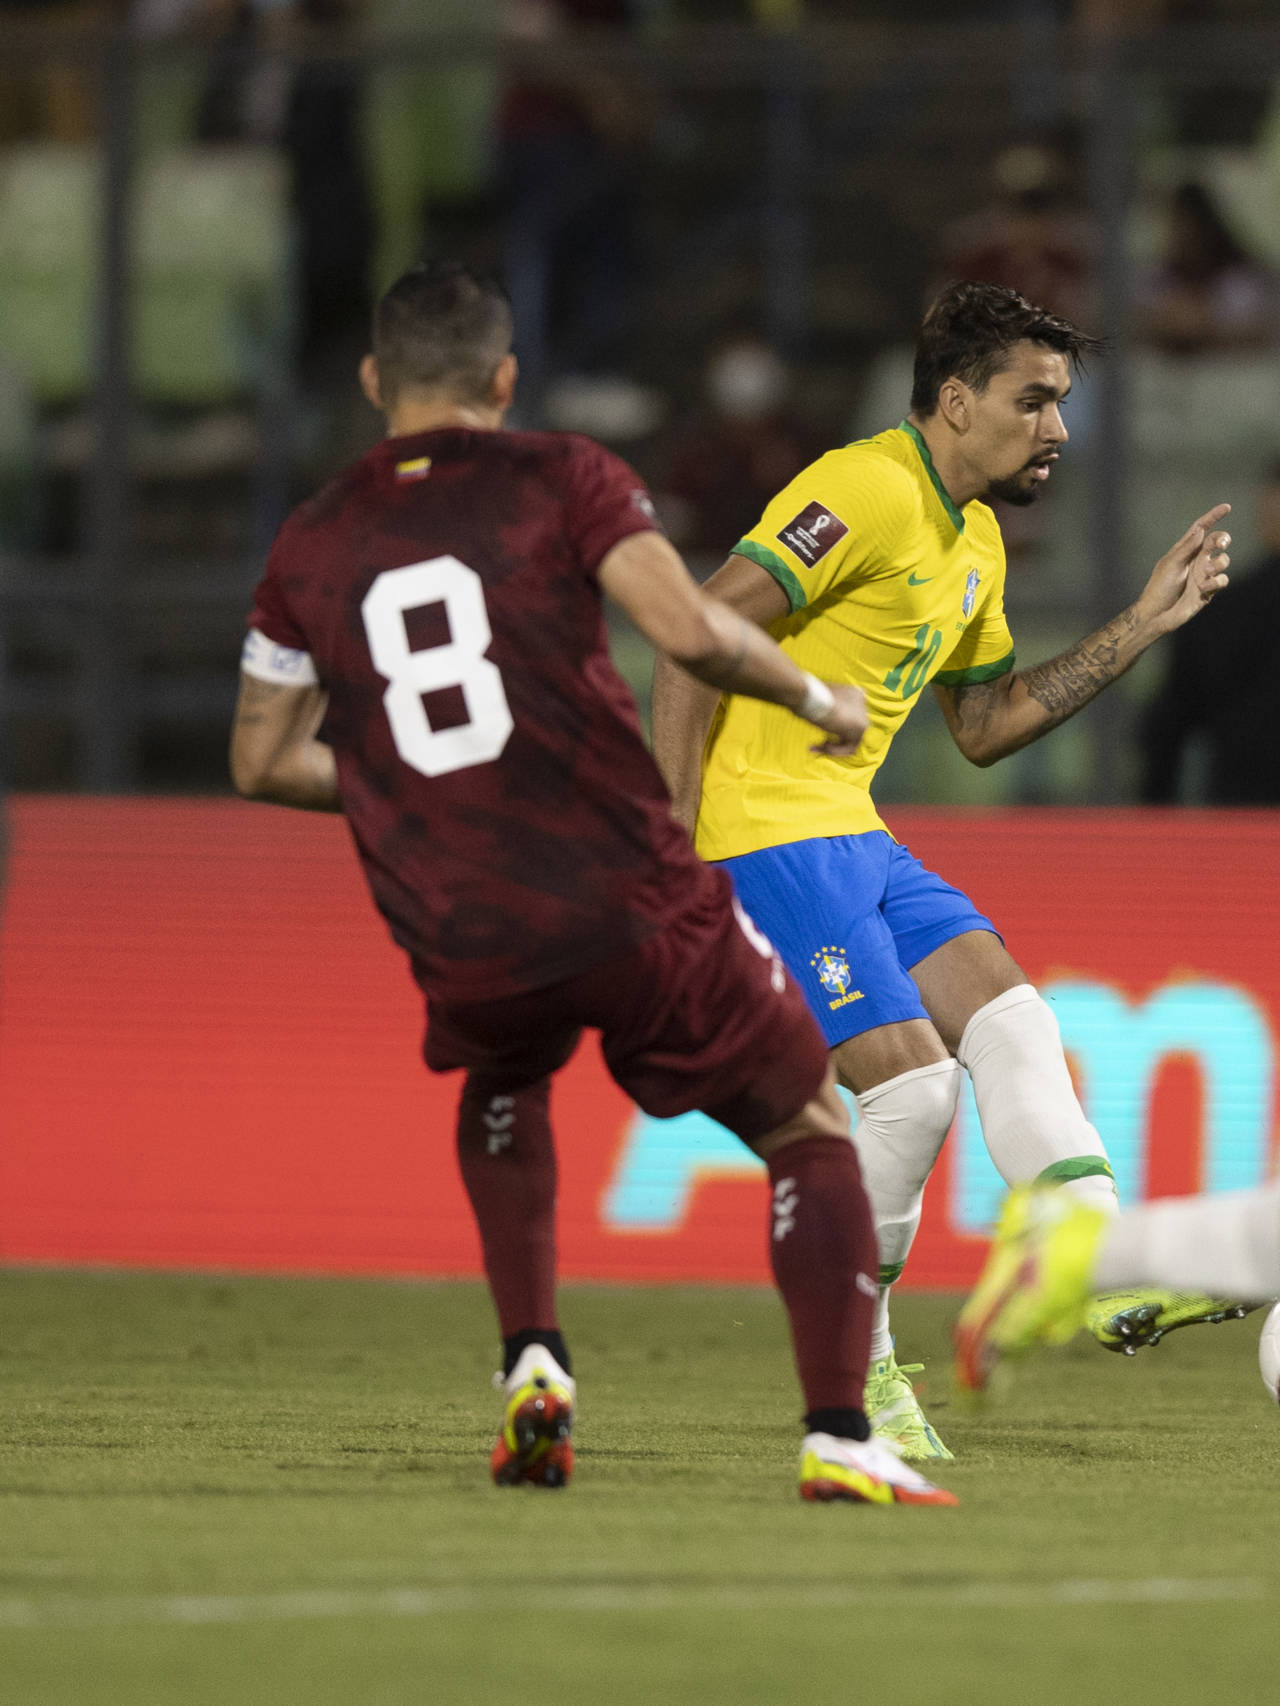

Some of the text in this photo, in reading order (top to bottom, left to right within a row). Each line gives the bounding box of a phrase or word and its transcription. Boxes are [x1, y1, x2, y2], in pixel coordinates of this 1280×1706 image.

[361, 554, 515, 777] 8
[882, 623, 942, 700] 10
[829, 990, 865, 1010] BRASIL
